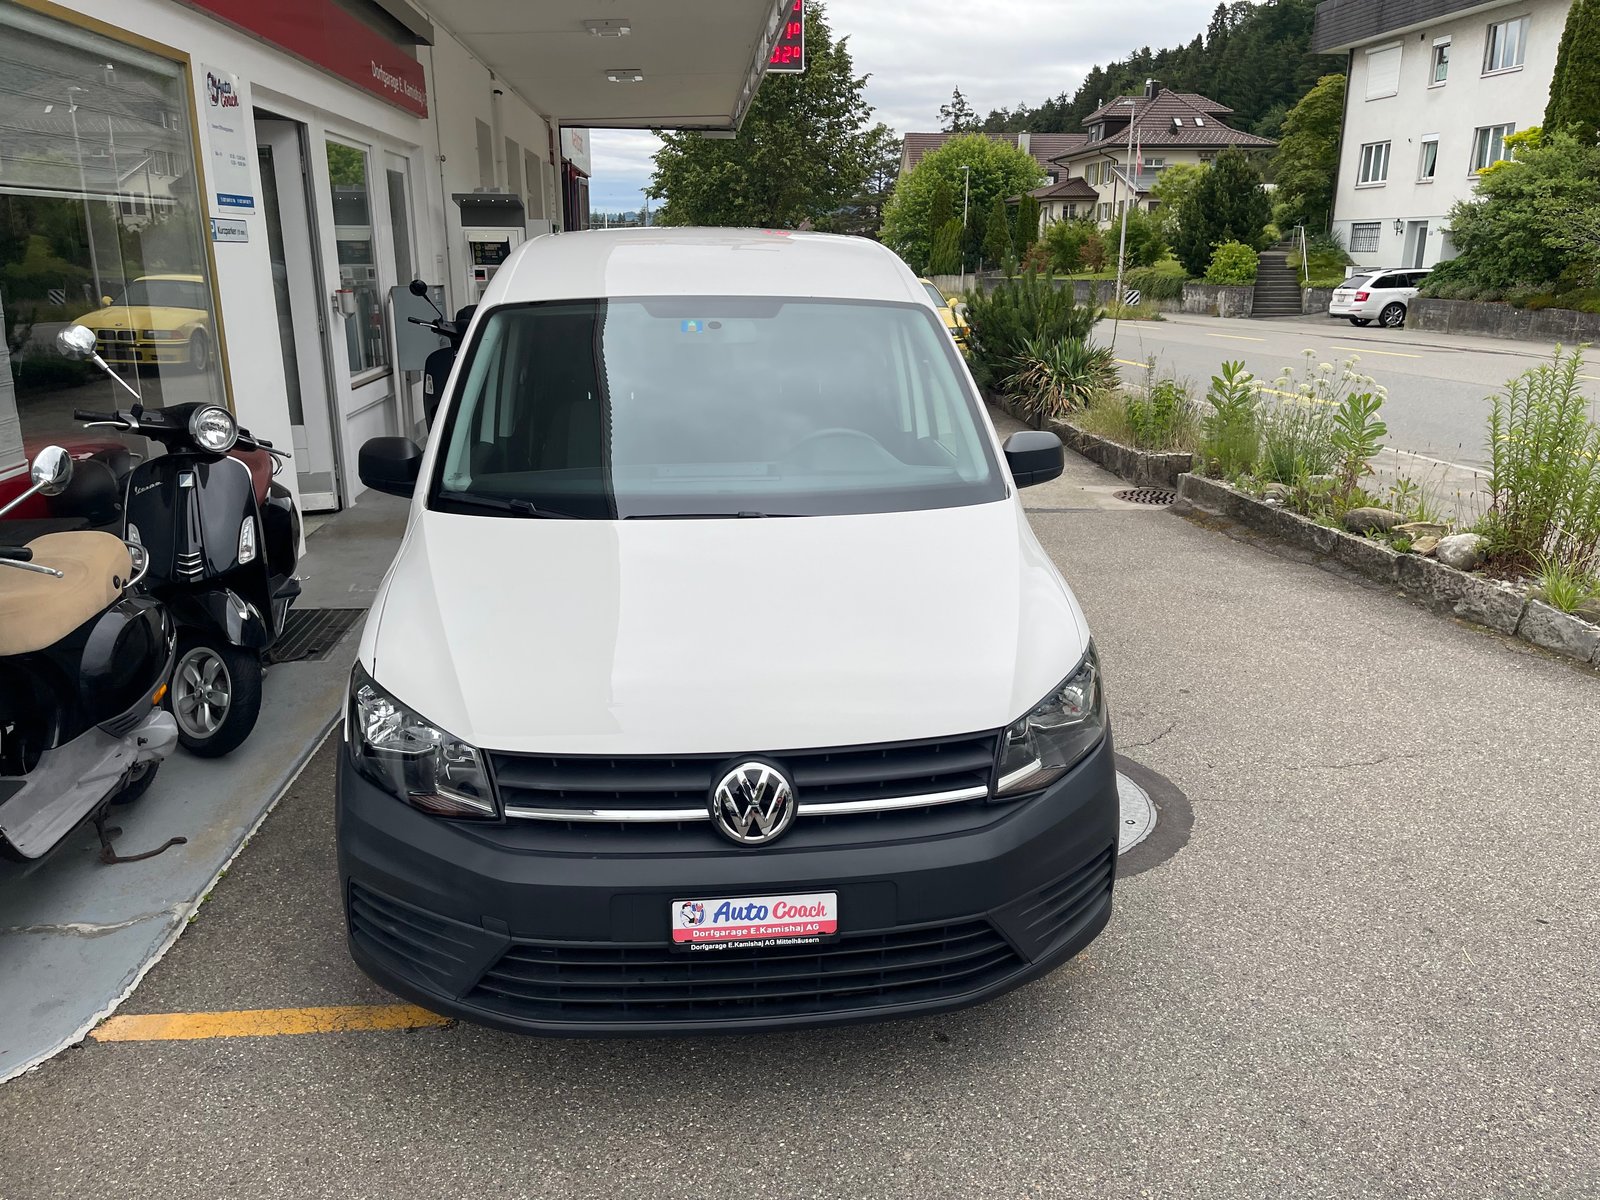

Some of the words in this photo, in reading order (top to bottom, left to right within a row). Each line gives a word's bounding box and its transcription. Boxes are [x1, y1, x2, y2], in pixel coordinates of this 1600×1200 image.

[713, 901, 769, 923] Auto
[772, 901, 827, 920] Coach
[693, 928, 748, 938] Dorfgarage
[750, 924, 804, 935] E.Kamishaj
[806, 923, 820, 931] AG
[690, 942, 727, 951] Dorfgarage
[728, 940, 764, 949] E.Kamishaj
[776, 937, 820, 945] Mittelhäusern
